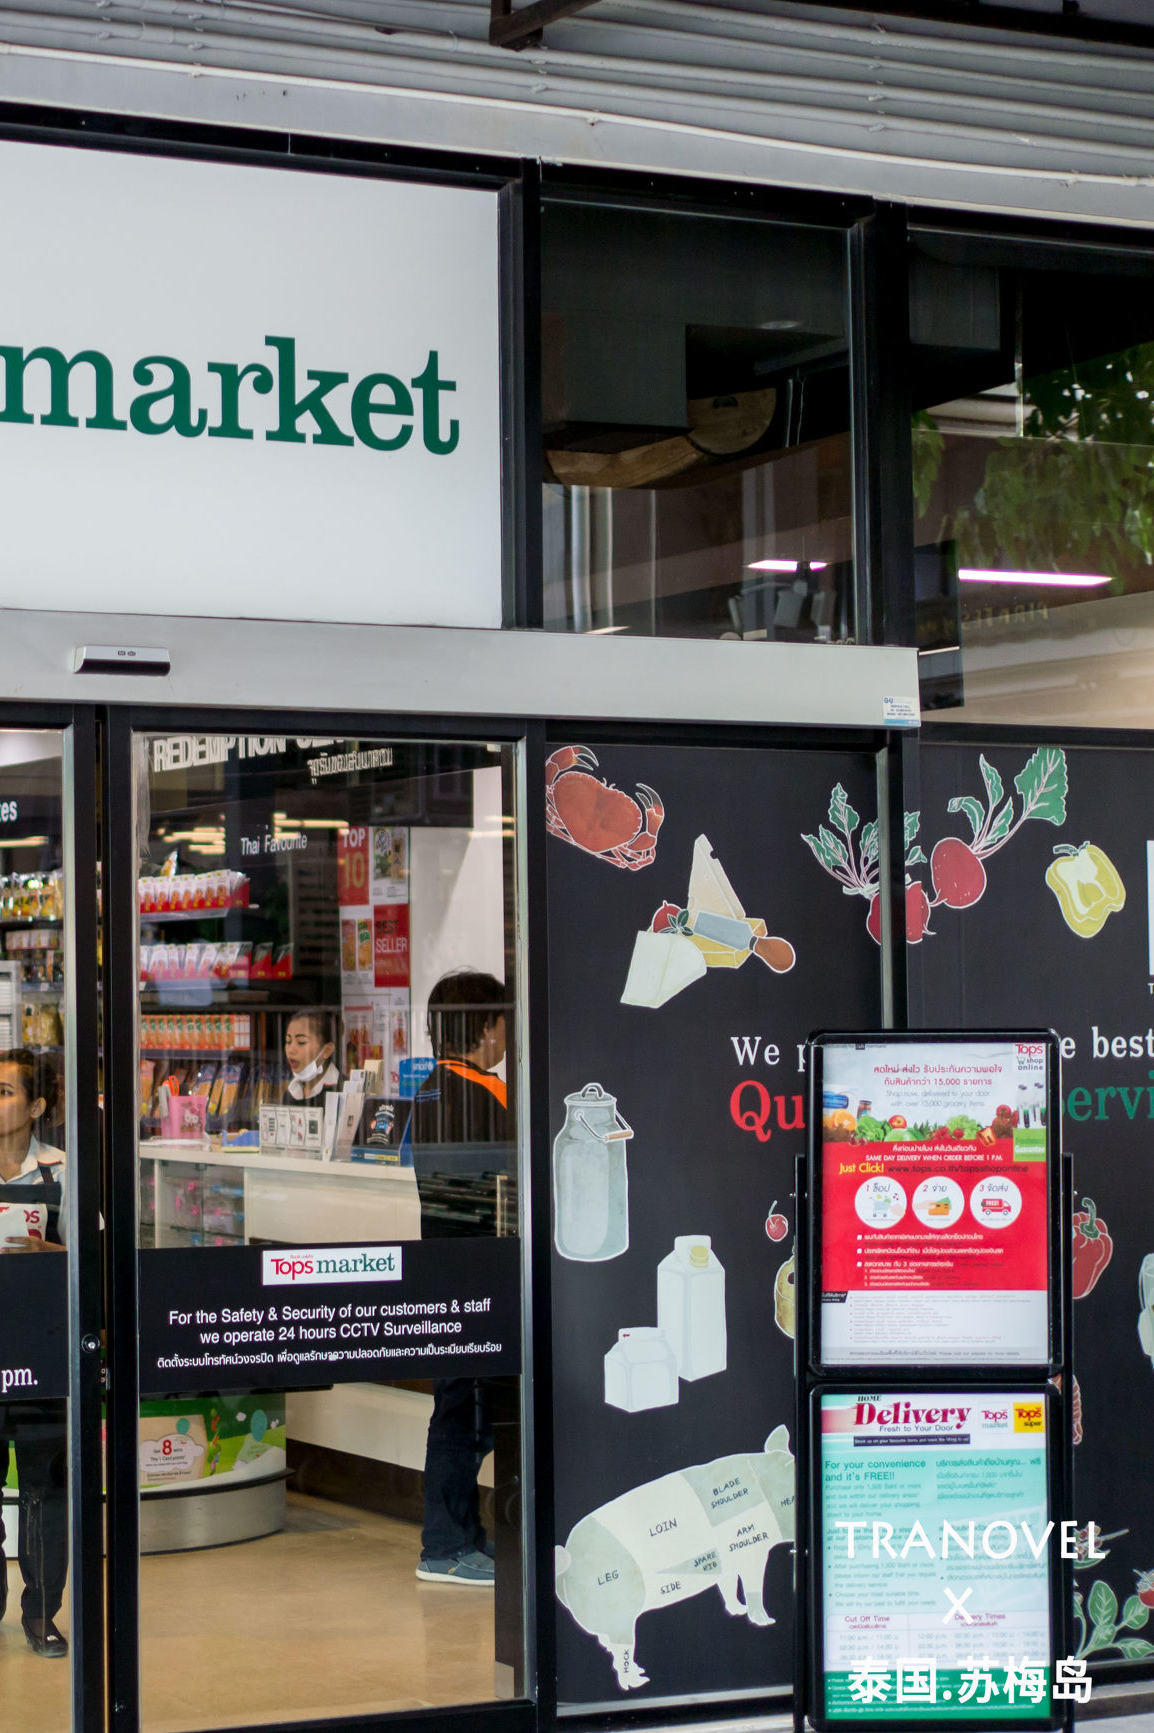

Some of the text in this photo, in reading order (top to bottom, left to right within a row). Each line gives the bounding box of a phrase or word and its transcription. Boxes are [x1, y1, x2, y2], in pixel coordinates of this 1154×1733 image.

[343, 827, 365, 847] TOP
[241, 836, 260, 855] Thai
[376, 938, 408, 952] SELLER
[731, 1037, 780, 1065] We
[1092, 1026, 1154, 1059] best
[1015, 1044, 1043, 1057] Tops
[1026, 1057, 1043, 1065] shop
[731, 1069, 1154, 1142] Qu ervi
[839, 1163, 856, 1174] Just
[858, 1163, 884, 1173] Click!
[923, 1184, 928, 1192] 2
[979, 1184, 984, 1192] 3
[271, 1253, 395, 1280] Tops market
[169, 1298, 491, 1326] For the Safety & Security of our customers & staff
[200, 1320, 462, 1347] we operate 24 hours CCTV Surveillance
[1, 1369, 38, 1394] pm.
[854, 1402, 971, 1430] Delivery
[982, 1410, 1008, 1422] Tops
[1016, 1408, 1042, 1420] Tops
[162, 1440, 172, 1455] 8
[825, 1459, 926, 1471] For your convenience
[826, 1473, 842, 1481] and
[846, 1472, 860, 1481] it's
[712, 1477, 741, 1497] BLADE
[711, 1488, 749, 1509] SHOULDER
[649, 1518, 678, 1537] LOIN
[737, 1524, 755, 1537] ARM
[729, 1532, 769, 1552] SHOULDER
[694, 1552, 717, 1567] SPARE
[598, 1569, 619, 1586] LEG
[660, 1581, 682, 1595] SIDE
[874, 1615, 890, 1623] Time
